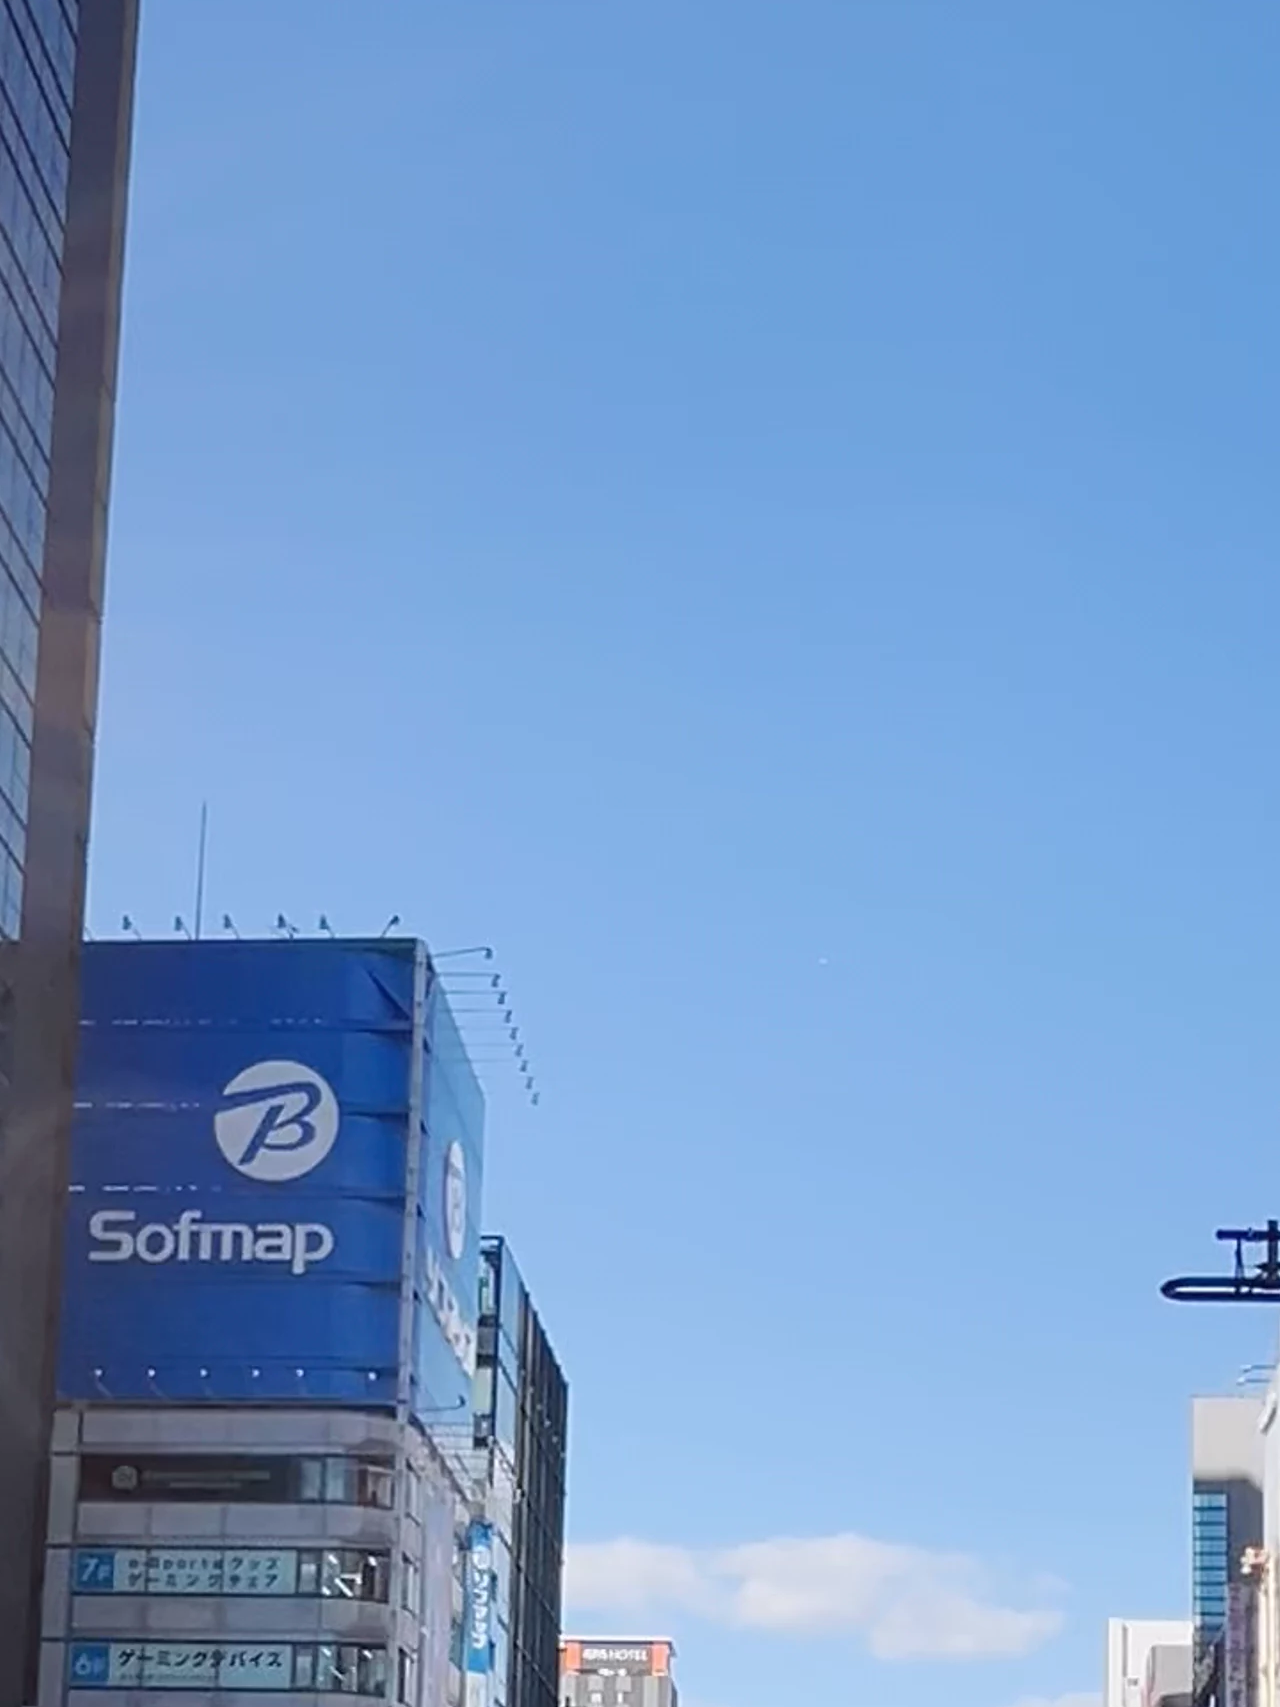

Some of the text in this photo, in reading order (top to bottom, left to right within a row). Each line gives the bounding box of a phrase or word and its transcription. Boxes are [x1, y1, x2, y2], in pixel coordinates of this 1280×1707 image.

[88, 1208, 336, 1275] Sofmap
[118, 1648, 284, 1670] ゲーミングデバイス
